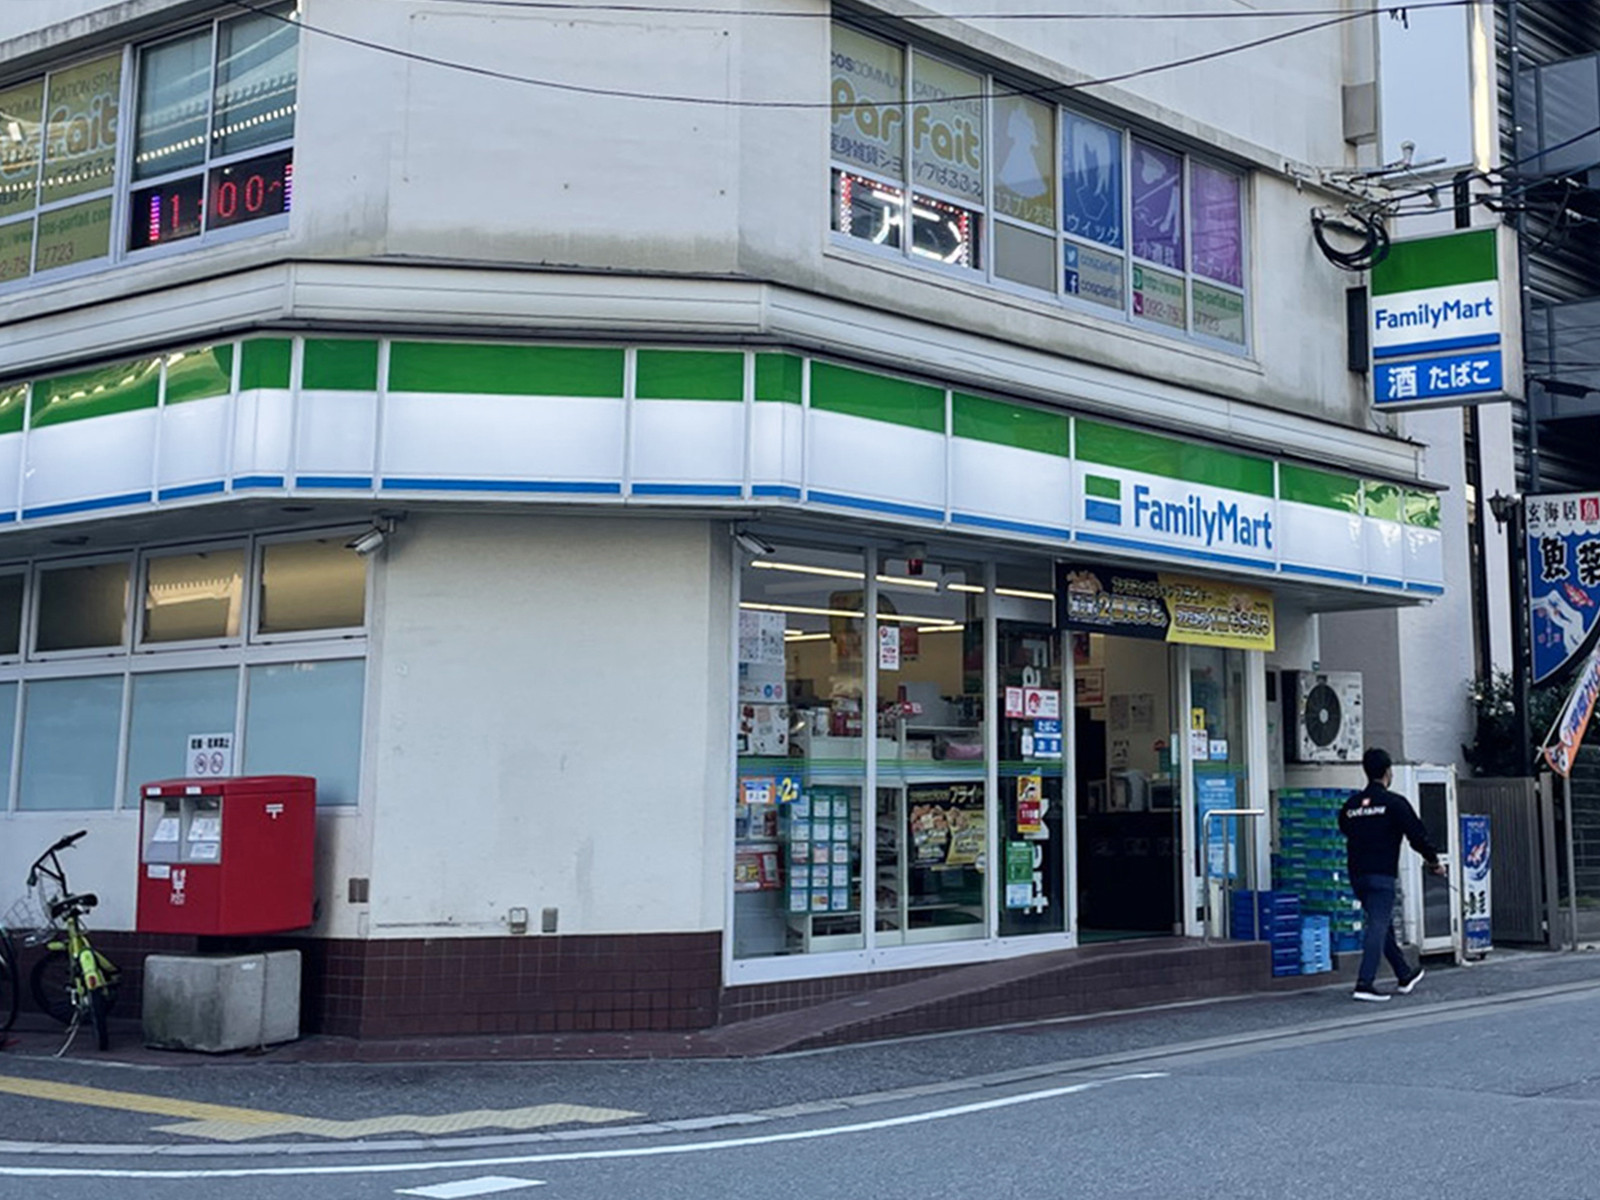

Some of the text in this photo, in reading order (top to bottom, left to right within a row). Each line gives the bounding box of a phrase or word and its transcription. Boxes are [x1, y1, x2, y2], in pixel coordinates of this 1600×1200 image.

[1375, 297, 1493, 330] FamilyMart
[1388, 360, 1491, 398] 酒 たばこ
[1133, 484, 1272, 550] FamilyMart
